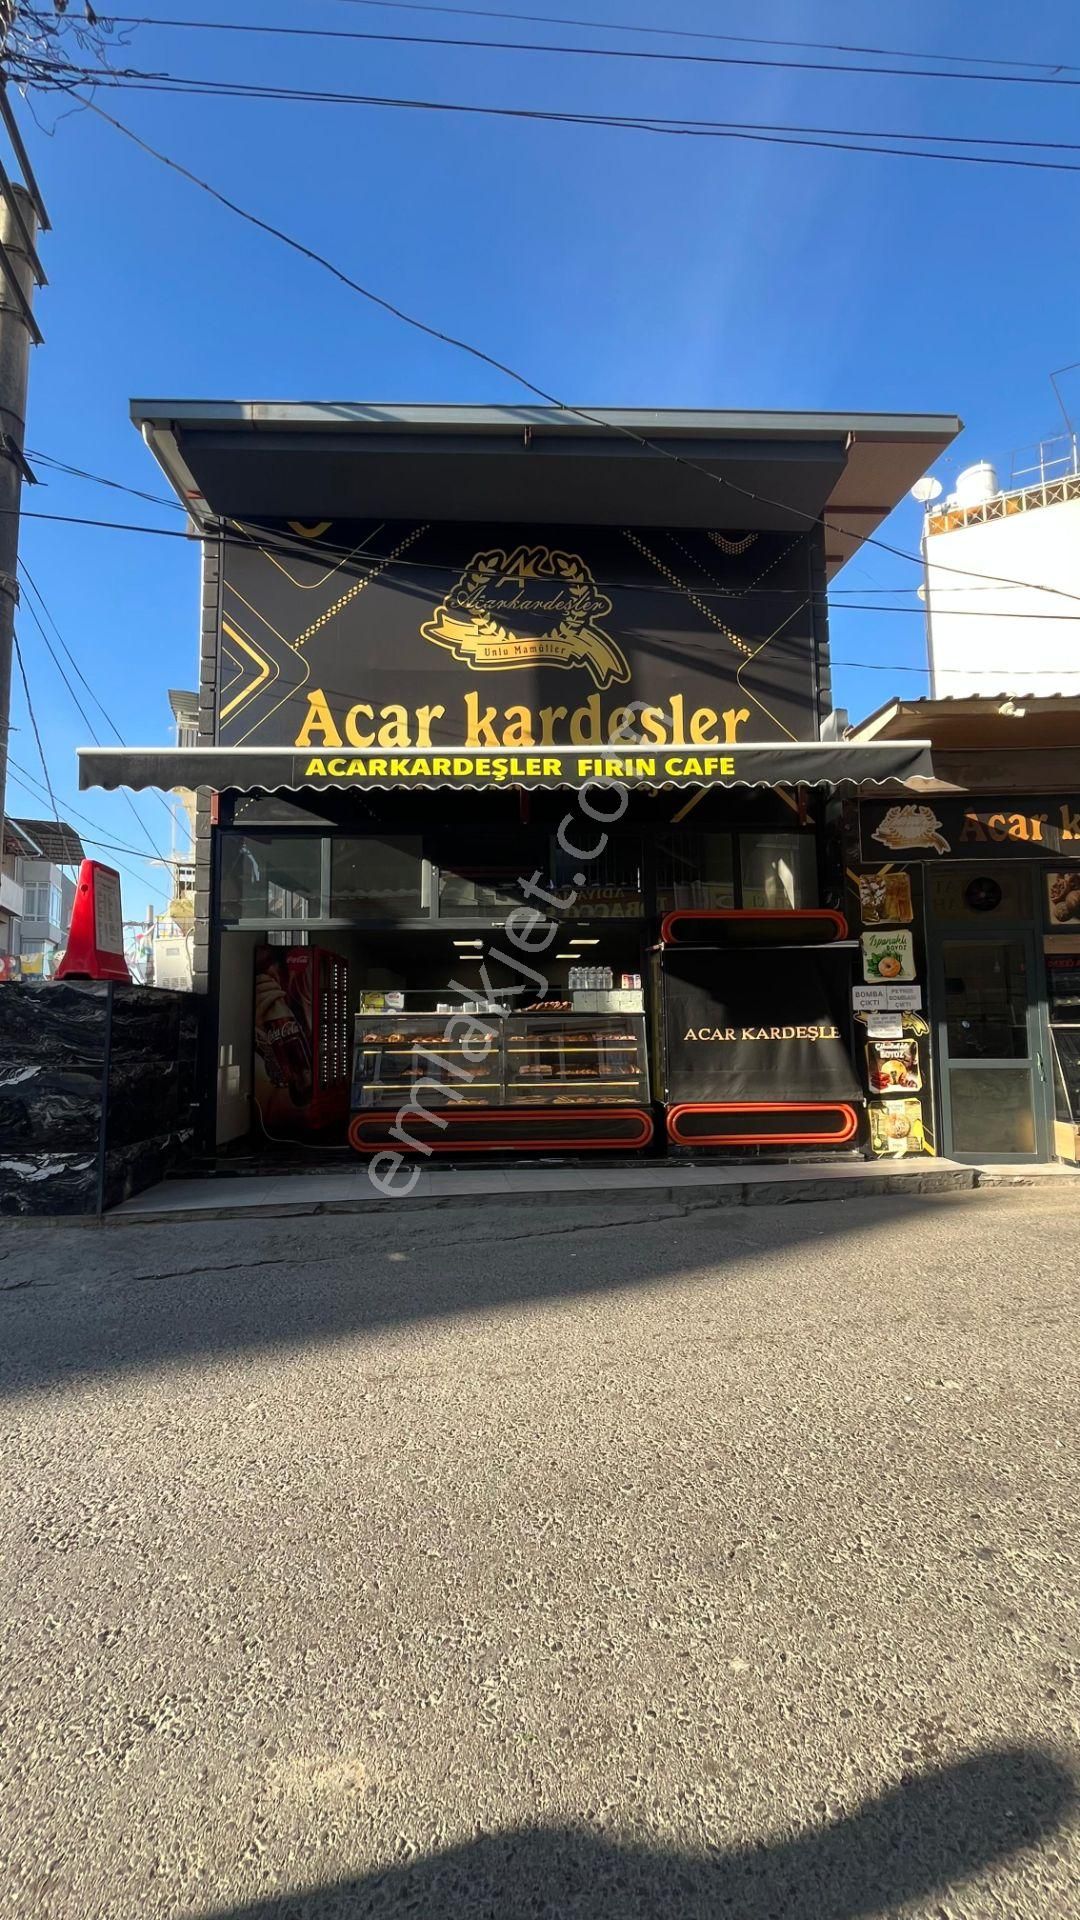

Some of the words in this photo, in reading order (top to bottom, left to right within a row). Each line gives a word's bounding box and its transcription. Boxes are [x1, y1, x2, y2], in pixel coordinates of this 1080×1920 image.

[294, 688, 446, 748] Acar
[304, 756, 563, 781] ACARKARDEŞLER
[577, 756, 656, 778] FIRIN
[664, 755, 736, 777] CAFE
[960, 806, 1049, 842] Acar
[683, 1028, 737, 1041] ACAR
